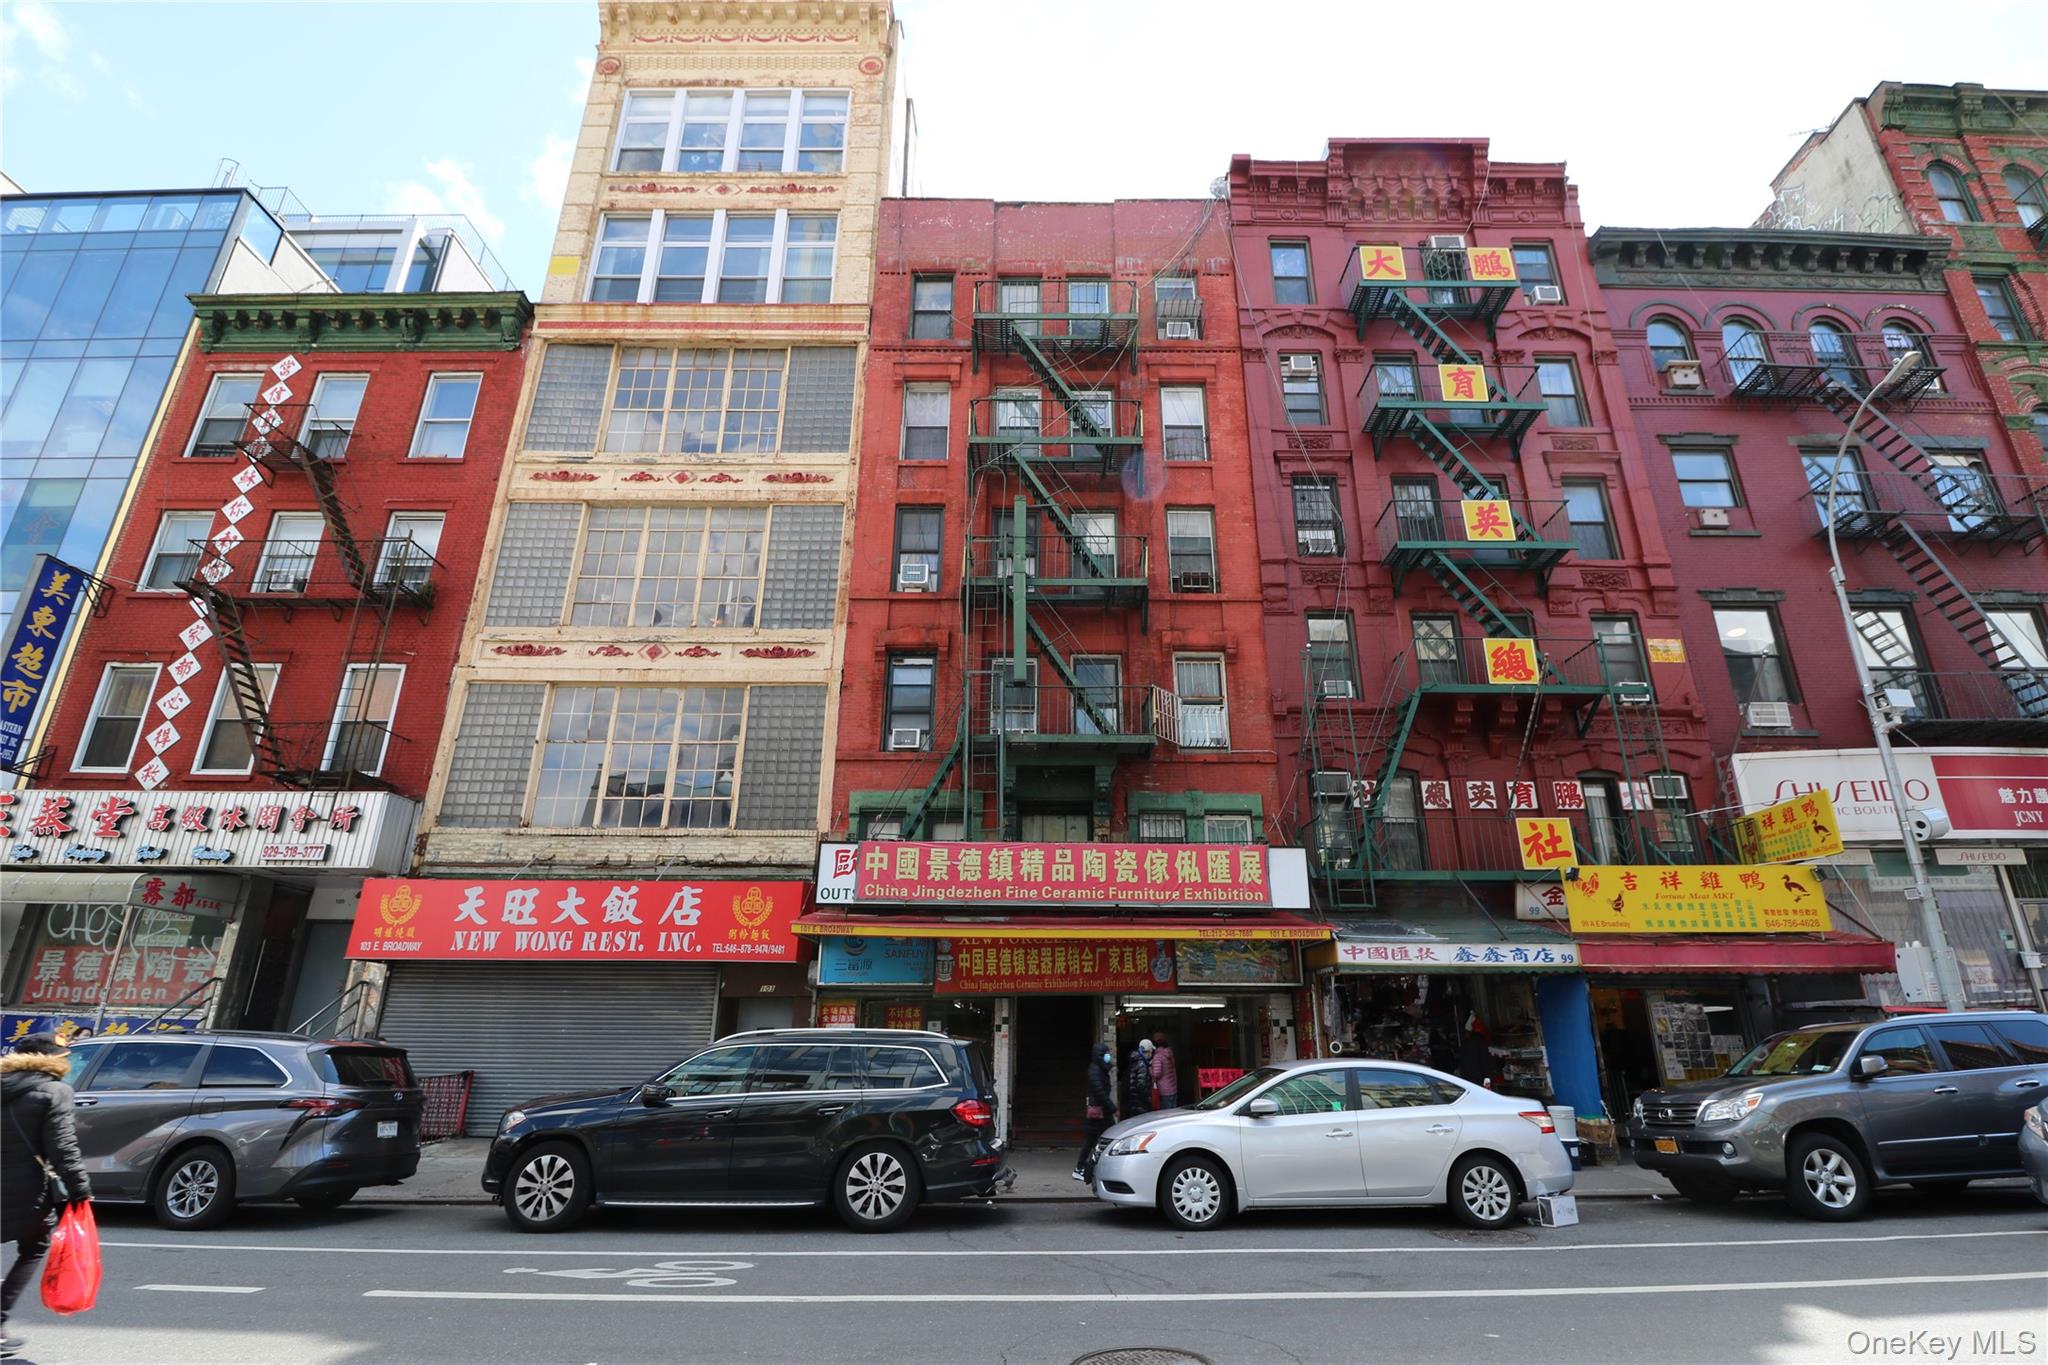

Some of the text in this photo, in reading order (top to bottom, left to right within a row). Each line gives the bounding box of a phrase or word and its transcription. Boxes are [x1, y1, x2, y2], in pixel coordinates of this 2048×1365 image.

[1366, 248, 1402, 278] 大
[1446, 366, 1476, 399] 育
[1470, 502, 1508, 538] 英
[1854, 806, 1898, 816] BOUTI
[2014, 810, 2044, 827] JCNY
[262, 845, 325, 859] 929-318-3777
[1523, 822, 1572, 866] 社
[864, 883, 1264, 901] China Jingdezhen Fine Ceramic Furniture Exhibition
[1620, 870, 1766, 892] 吉祥雞鴨
[453, 885, 704, 926] 天旺大飯店
[382, 940, 423, 952] BROADWAY
[450, 930, 703, 954] NEW WONG REST. INC.
[958, 945, 1149, 977] 中国景德镇瓷器展销会厂家直销
[1560, 953, 1575, 964] 99
